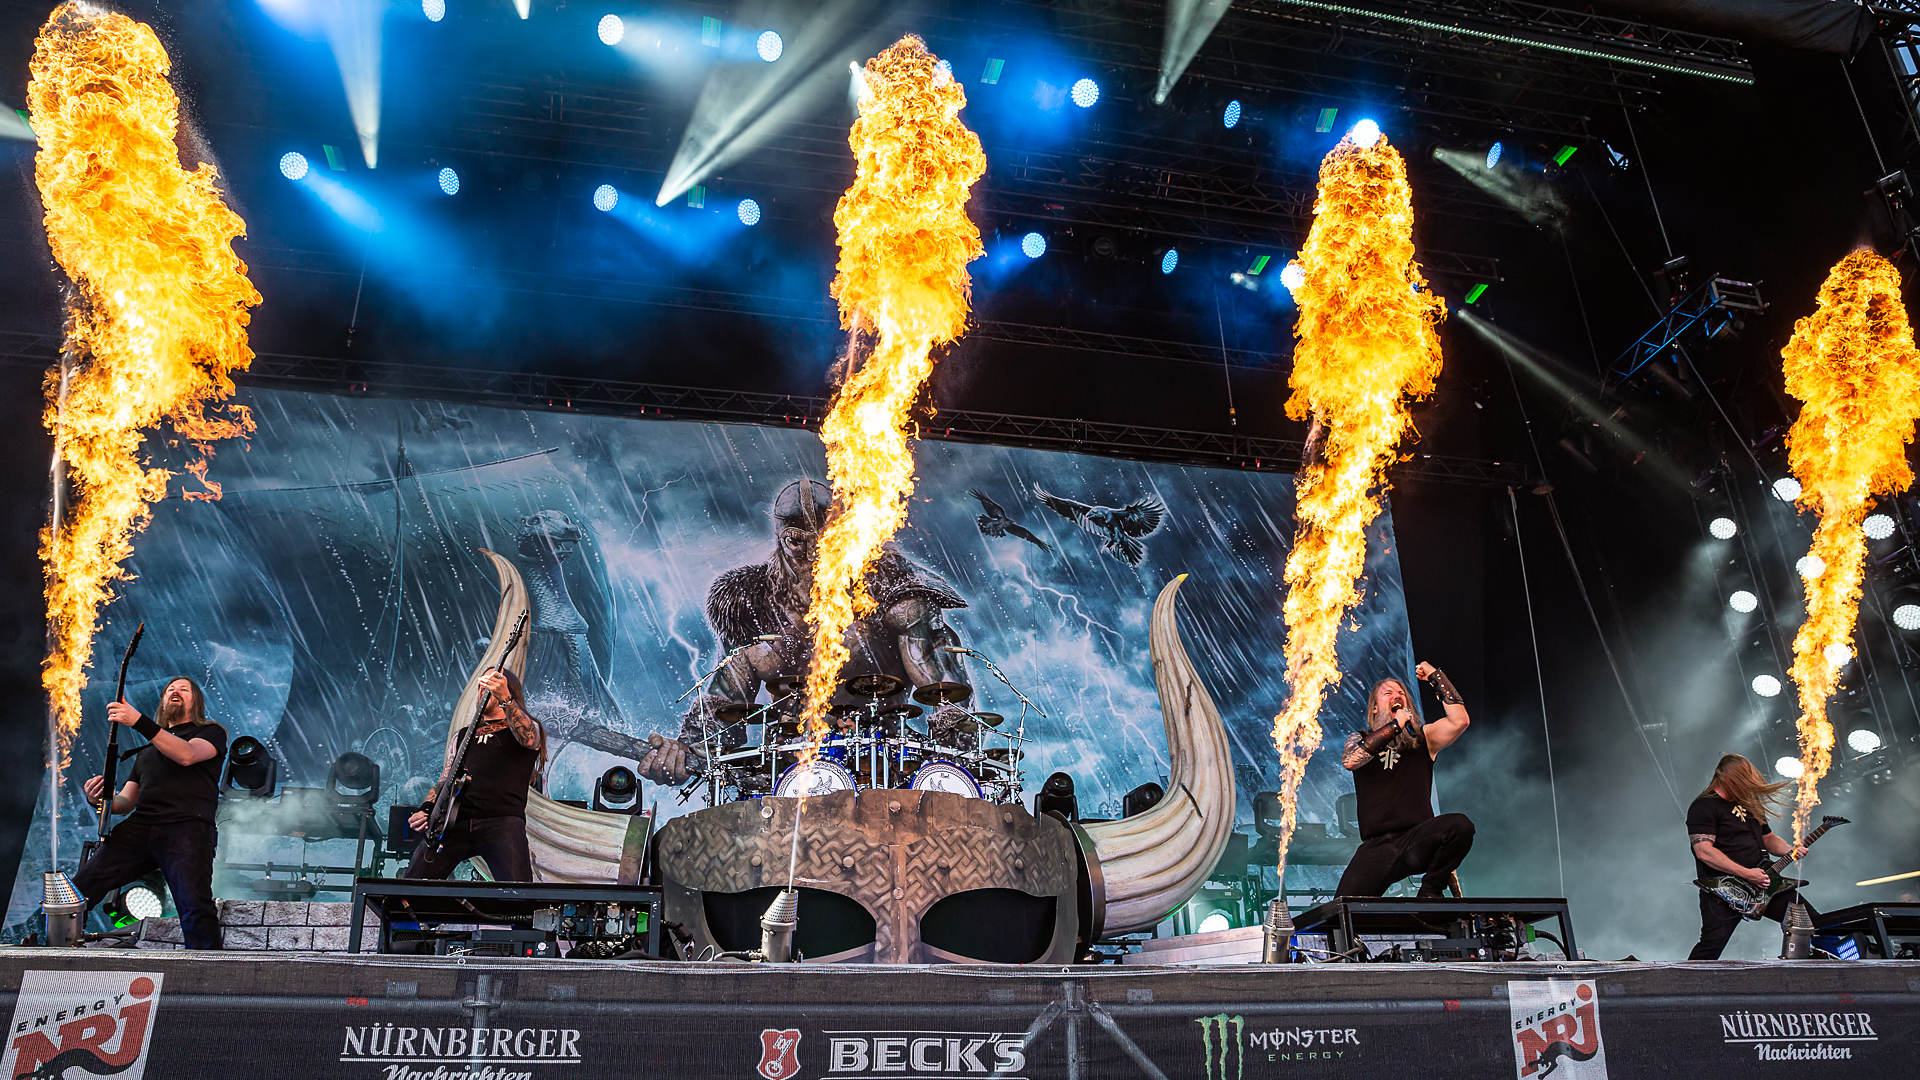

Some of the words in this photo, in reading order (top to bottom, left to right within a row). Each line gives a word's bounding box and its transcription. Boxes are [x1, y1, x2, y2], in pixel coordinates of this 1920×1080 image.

[16, 994, 124, 1033] ENERGY
[1515, 998, 1576, 1030] ENERGY
[1719, 1010, 1878, 1038] NÜRNBERGER
[341, 1022, 582, 1058] NÜRNBERGER
[829, 1032, 1026, 1073] BECK'S
[1754, 1042, 1852, 1061] Nachrichten
[1268, 1051, 1344, 1062] ENERGY
[382, 1064, 532, 1080] Nachrichten
